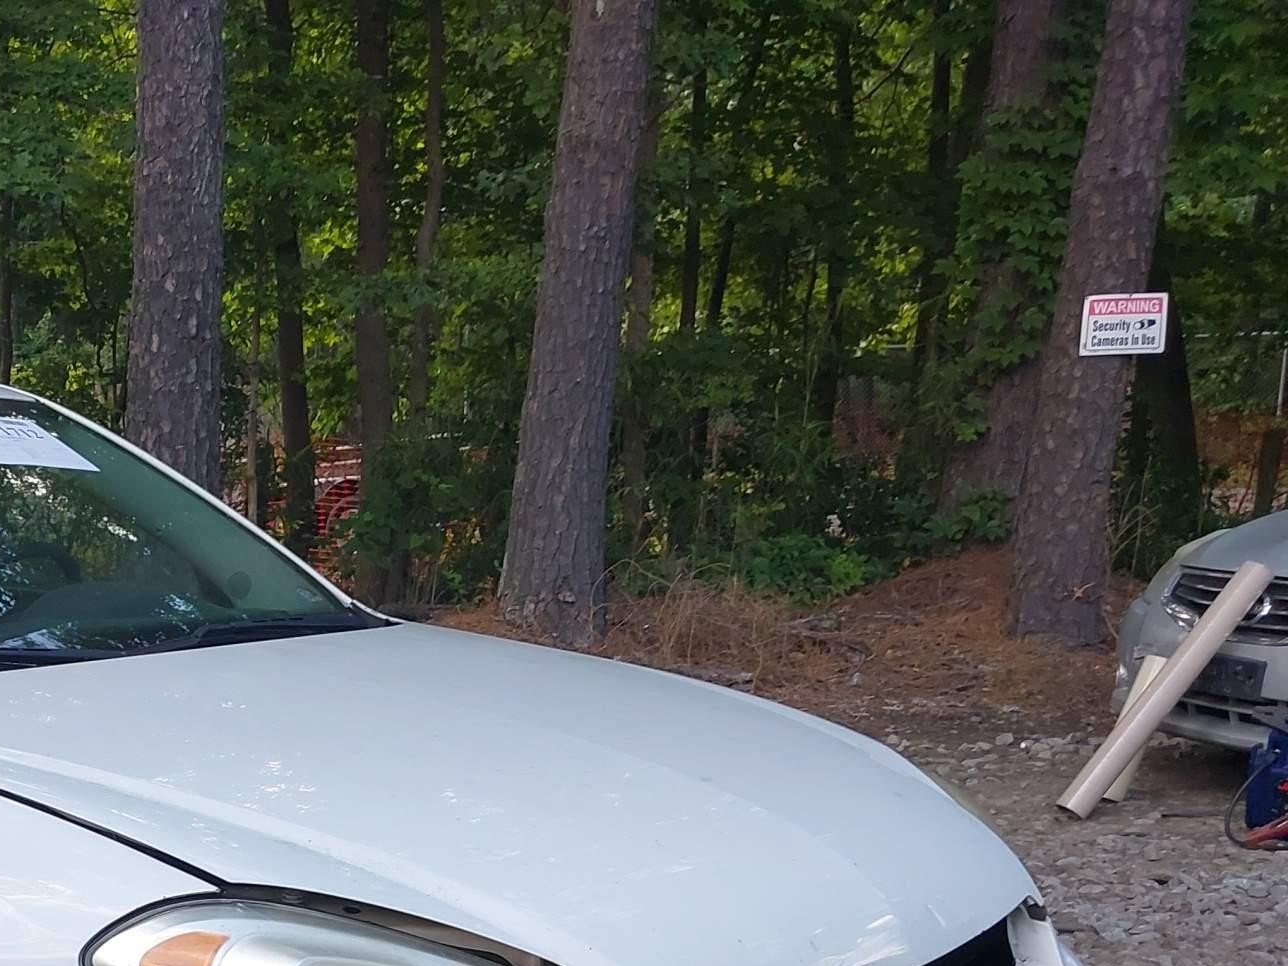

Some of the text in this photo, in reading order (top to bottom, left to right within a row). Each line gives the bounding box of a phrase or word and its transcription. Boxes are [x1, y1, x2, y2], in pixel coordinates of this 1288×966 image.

[1093, 299, 1160, 314] WARNING
[1092, 320, 1131, 333] Security
[1091, 334, 1156, 347] Cameras In Use
